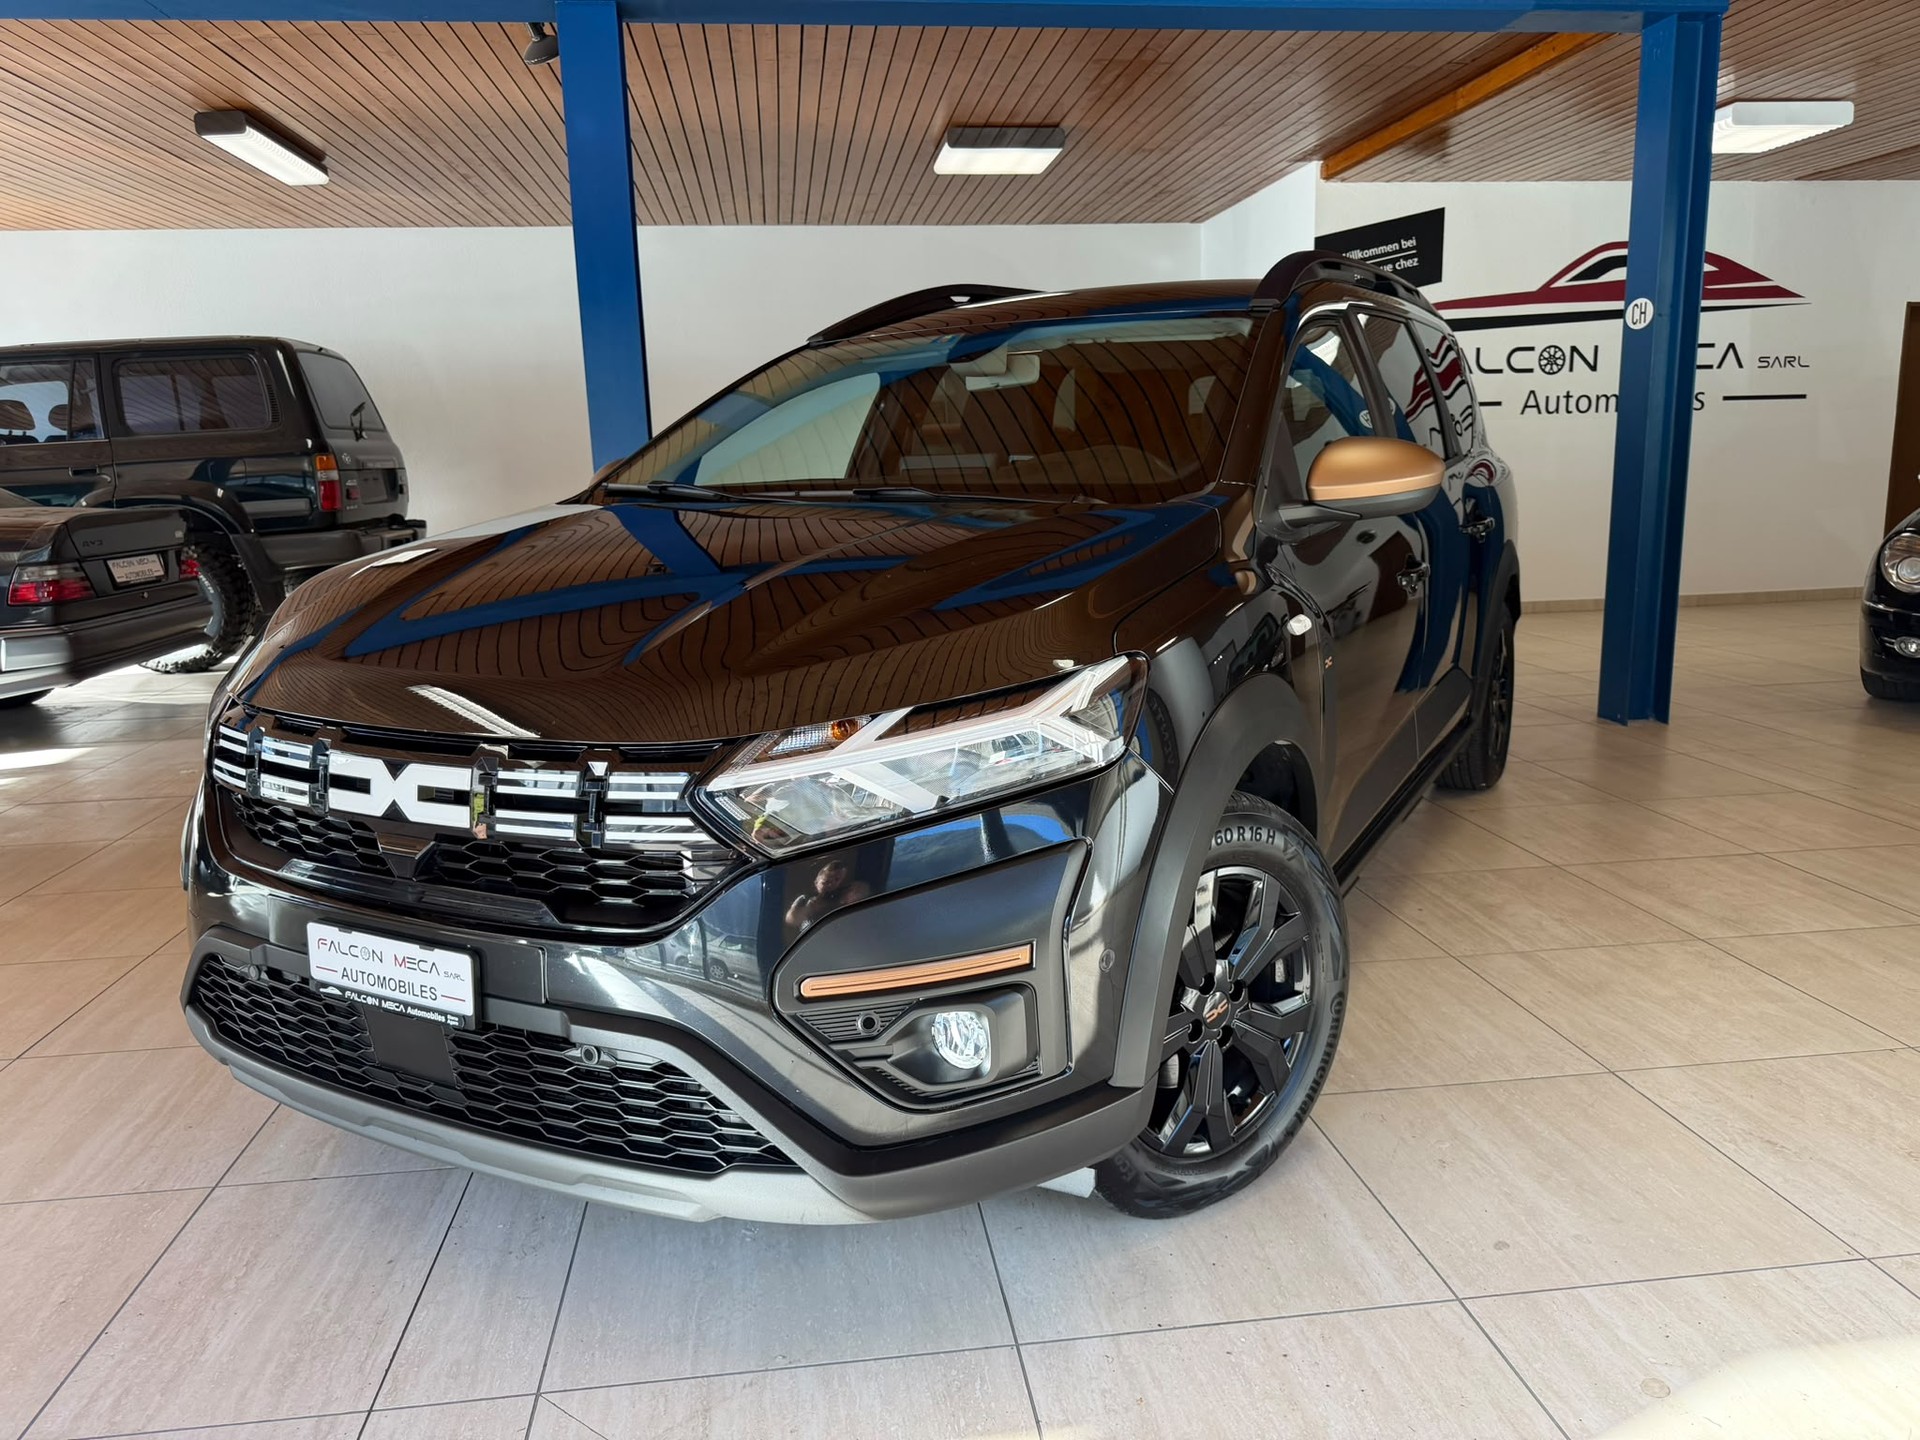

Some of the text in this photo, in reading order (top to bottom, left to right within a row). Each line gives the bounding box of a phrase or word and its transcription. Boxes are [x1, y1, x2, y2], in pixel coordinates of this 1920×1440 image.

[1342, 236, 1417, 260] illkommen bei
[1395, 257, 1419, 270] chez
[1631, 302, 1647, 325] CH
[1460, 342, 1810, 375] LCON CA SARL
[1212, 827, 1234, 846] 60
[317, 937, 465, 981] FALCON MECA SARL
[341, 967, 438, 1001] AUTOMOBILES
[344, 990, 380, 1007] FALCON
[381, 1000, 406, 1013] MECA
[407, 1006, 446, 1022] Automobiles
